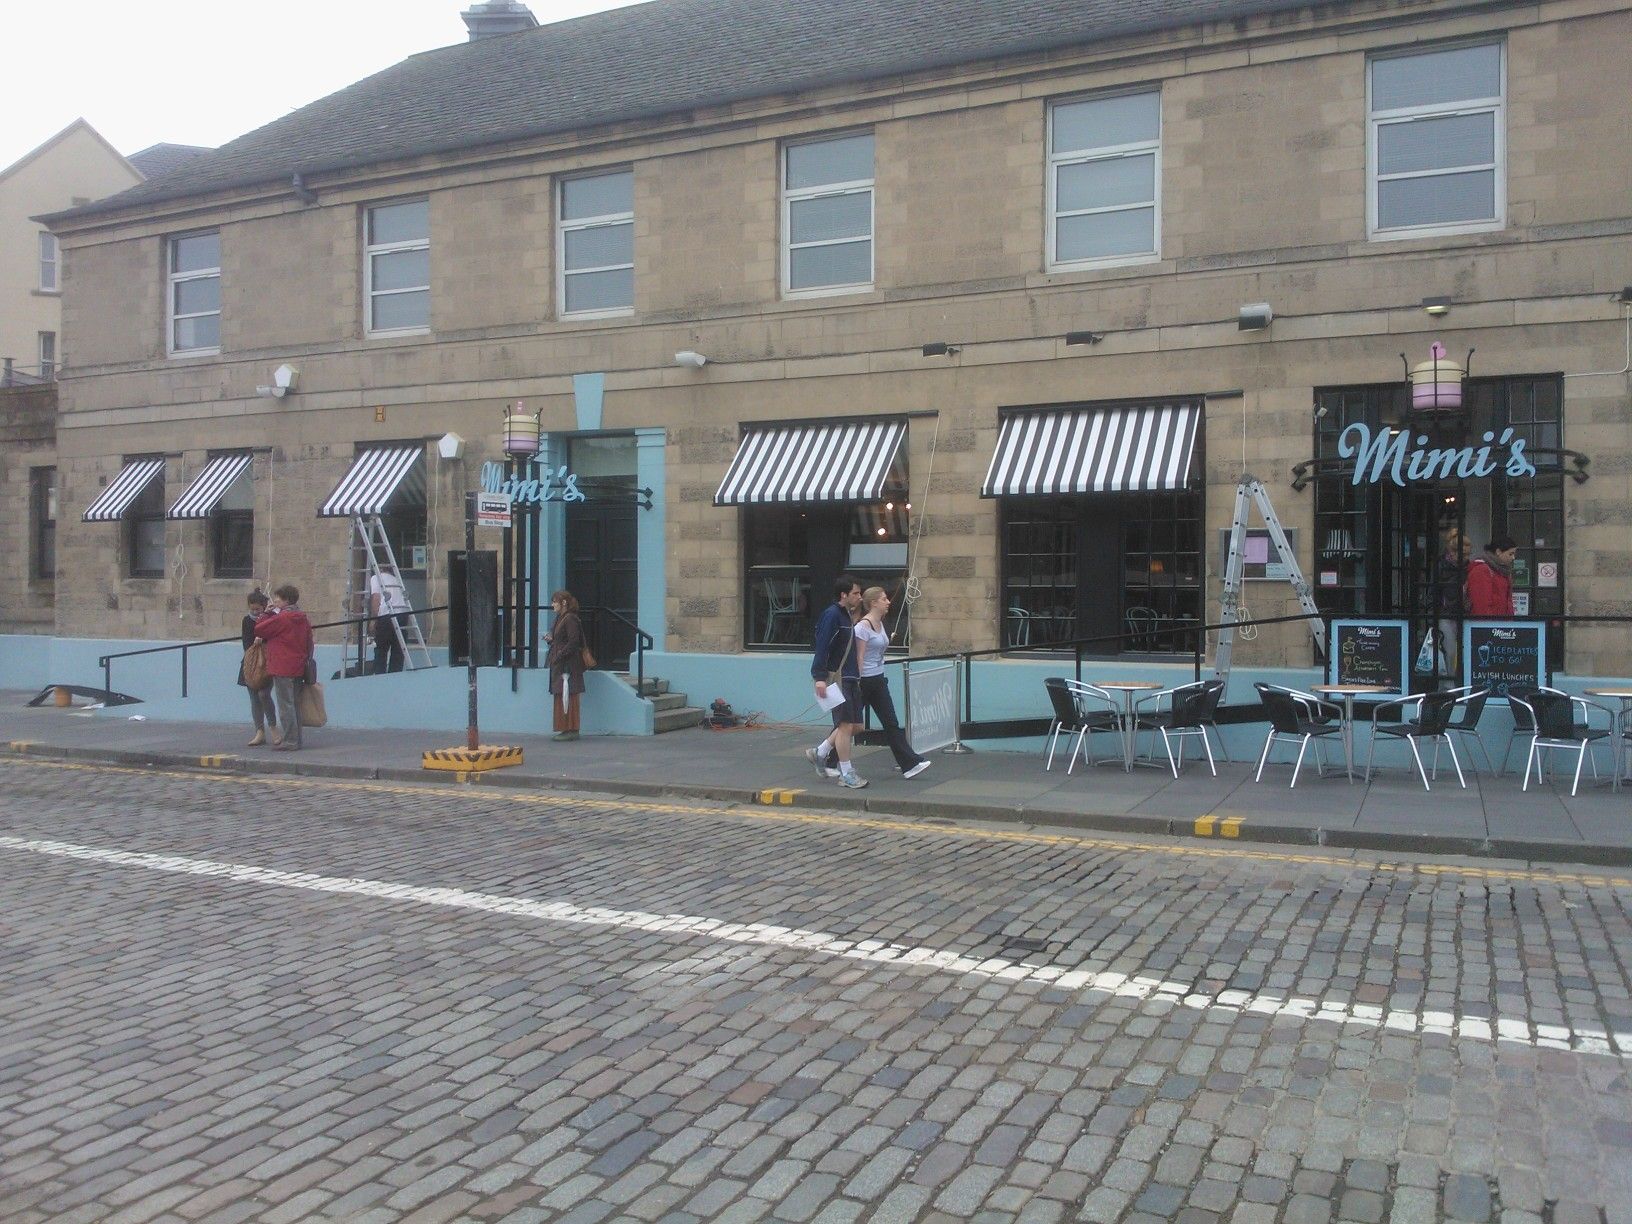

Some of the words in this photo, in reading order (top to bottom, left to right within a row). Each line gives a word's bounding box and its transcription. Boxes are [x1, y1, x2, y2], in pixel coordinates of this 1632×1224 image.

[1338, 422, 1537, 487] Mimi's
[480, 461, 586, 503] Mimi's
[1491, 628, 1517, 637] Mimi's
[1491, 655, 1504, 663] TO
[1472, 671, 1500, 680] LAVISH
[1501, 672, 1535, 682] LUNCHES
